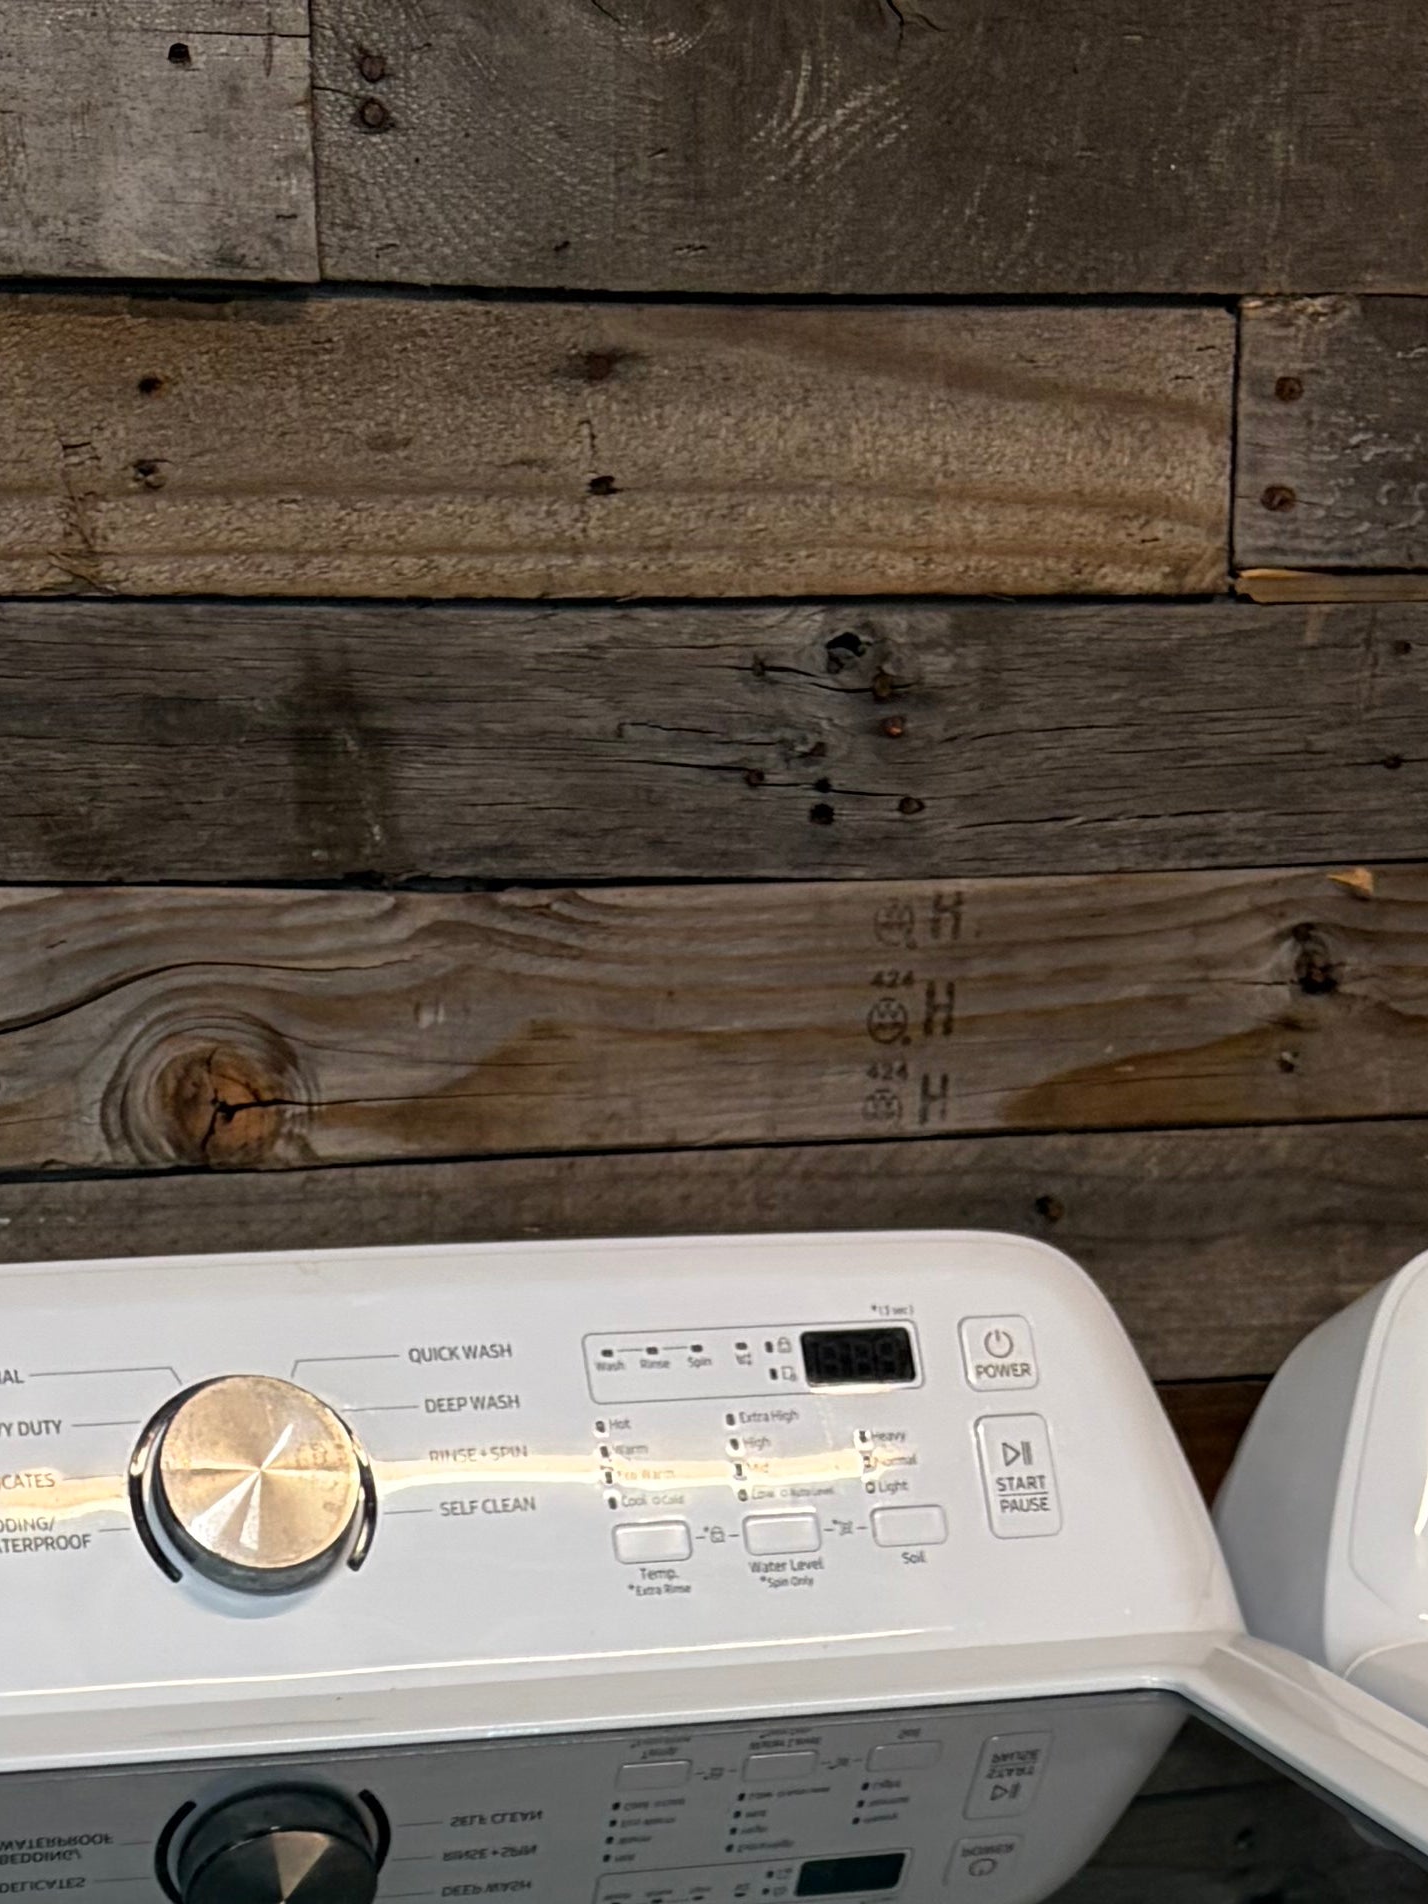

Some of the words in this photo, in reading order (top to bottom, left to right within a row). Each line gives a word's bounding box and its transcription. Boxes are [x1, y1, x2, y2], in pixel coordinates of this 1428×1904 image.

[923, 980, 956, 1037] H
[408, 1345, 460, 1364] QUICK
[461, 1343, 513, 1361] WASH
[687, 1356, 713, 1370] Spin
[974, 1363, 1032, 1379] POWER
[424, 1396, 467, 1414] DEEP
[469, 1394, 521, 1411] WASH
[609, 1418, 632, 1430] Hot
[739, 1410, 769, 1424] Extra
[770, 1409, 800, 1424] High
[17, 1420, 63, 1437] DUTY
[871, 1431, 906, 1442] Heavy
[429, 1447, 477, 1463] RINSE
[490, 1445, 529, 1461] SPIN
[878, 1480, 910, 1495] Light
[995, 1475, 1047, 1492] START
[439, 1500, 479, 1517] SELF
[481, 1496, 537, 1515] CLEAN
[1000, 1496, 1051, 1513] PAUSE
[748, 1560, 788, 1574] Water
[790, 1557, 825, 1571] Level
[901, 1551, 927, 1565] Soil
